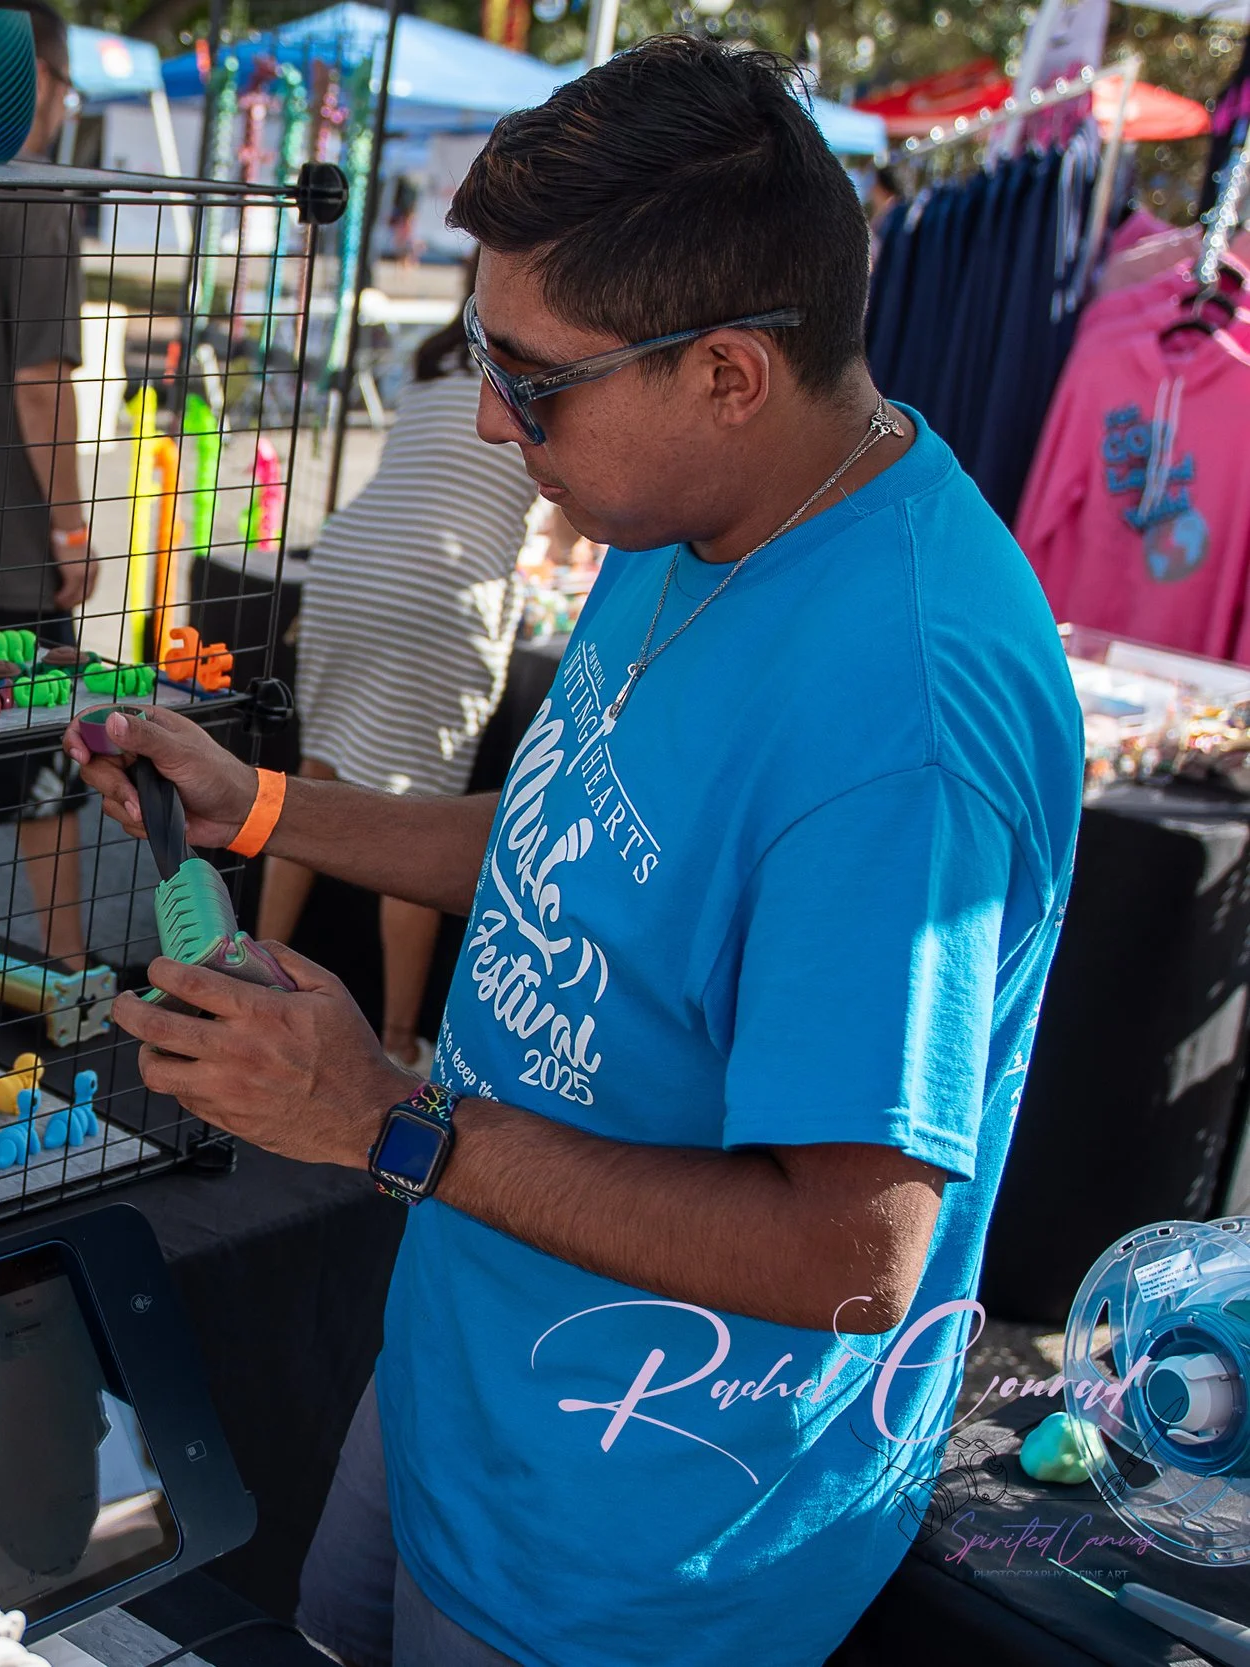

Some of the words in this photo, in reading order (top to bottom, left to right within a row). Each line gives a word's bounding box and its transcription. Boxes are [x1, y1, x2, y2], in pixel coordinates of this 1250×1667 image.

[581, 745, 660, 885] HEARTS
[467, 909, 602, 1074] Festival
[451, 1047, 477, 1087] keep
[518, 1048, 595, 1106] 2025
